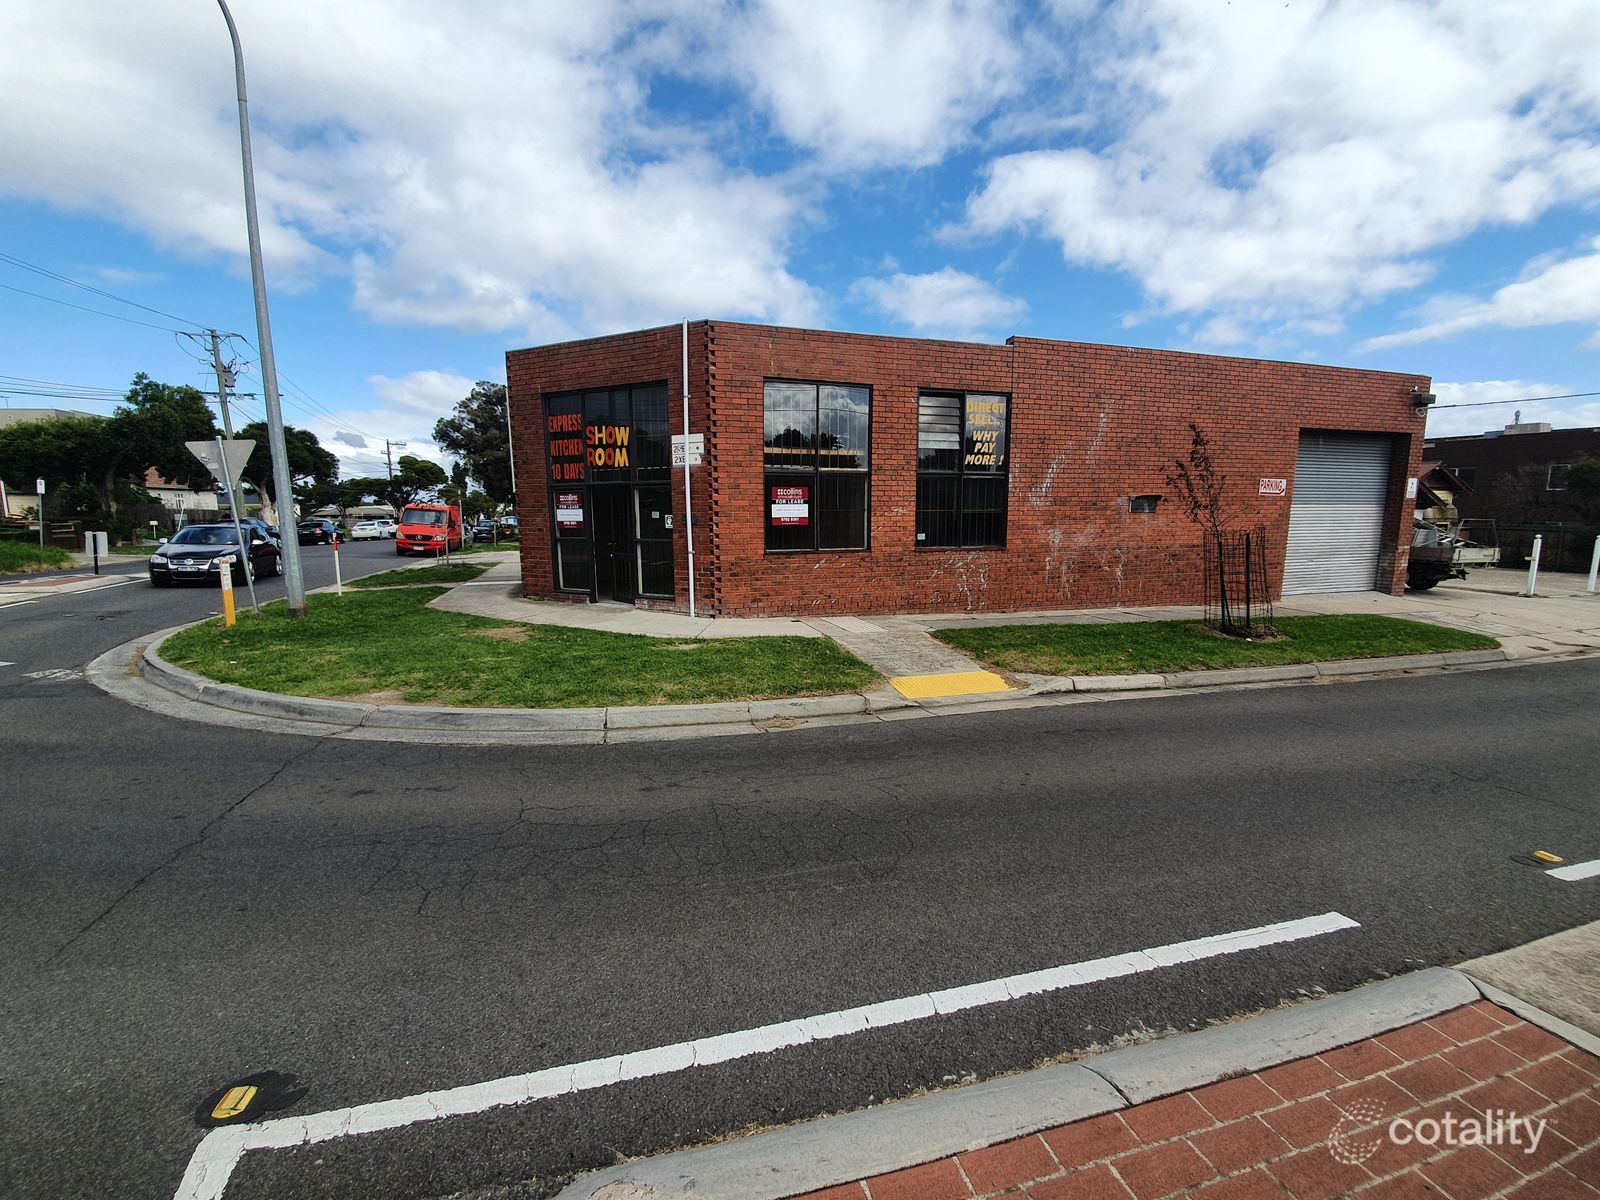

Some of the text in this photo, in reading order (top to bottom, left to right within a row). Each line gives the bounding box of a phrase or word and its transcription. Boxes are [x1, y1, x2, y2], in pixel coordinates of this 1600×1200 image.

[967, 402, 1005, 413] DIRECT
[548, 413, 582, 432] EXPRESS
[586, 425, 629, 446] SHOW
[972, 430, 999, 441] WHY
[550, 438, 584, 457] KITCHEN
[974, 442, 996, 453] PAY
[586, 448, 629, 467] ROOM
[964, 454, 996, 465] MORE
[551, 462, 585, 480] 10 DAYS
[1260, 480, 1283, 491] PARKING
